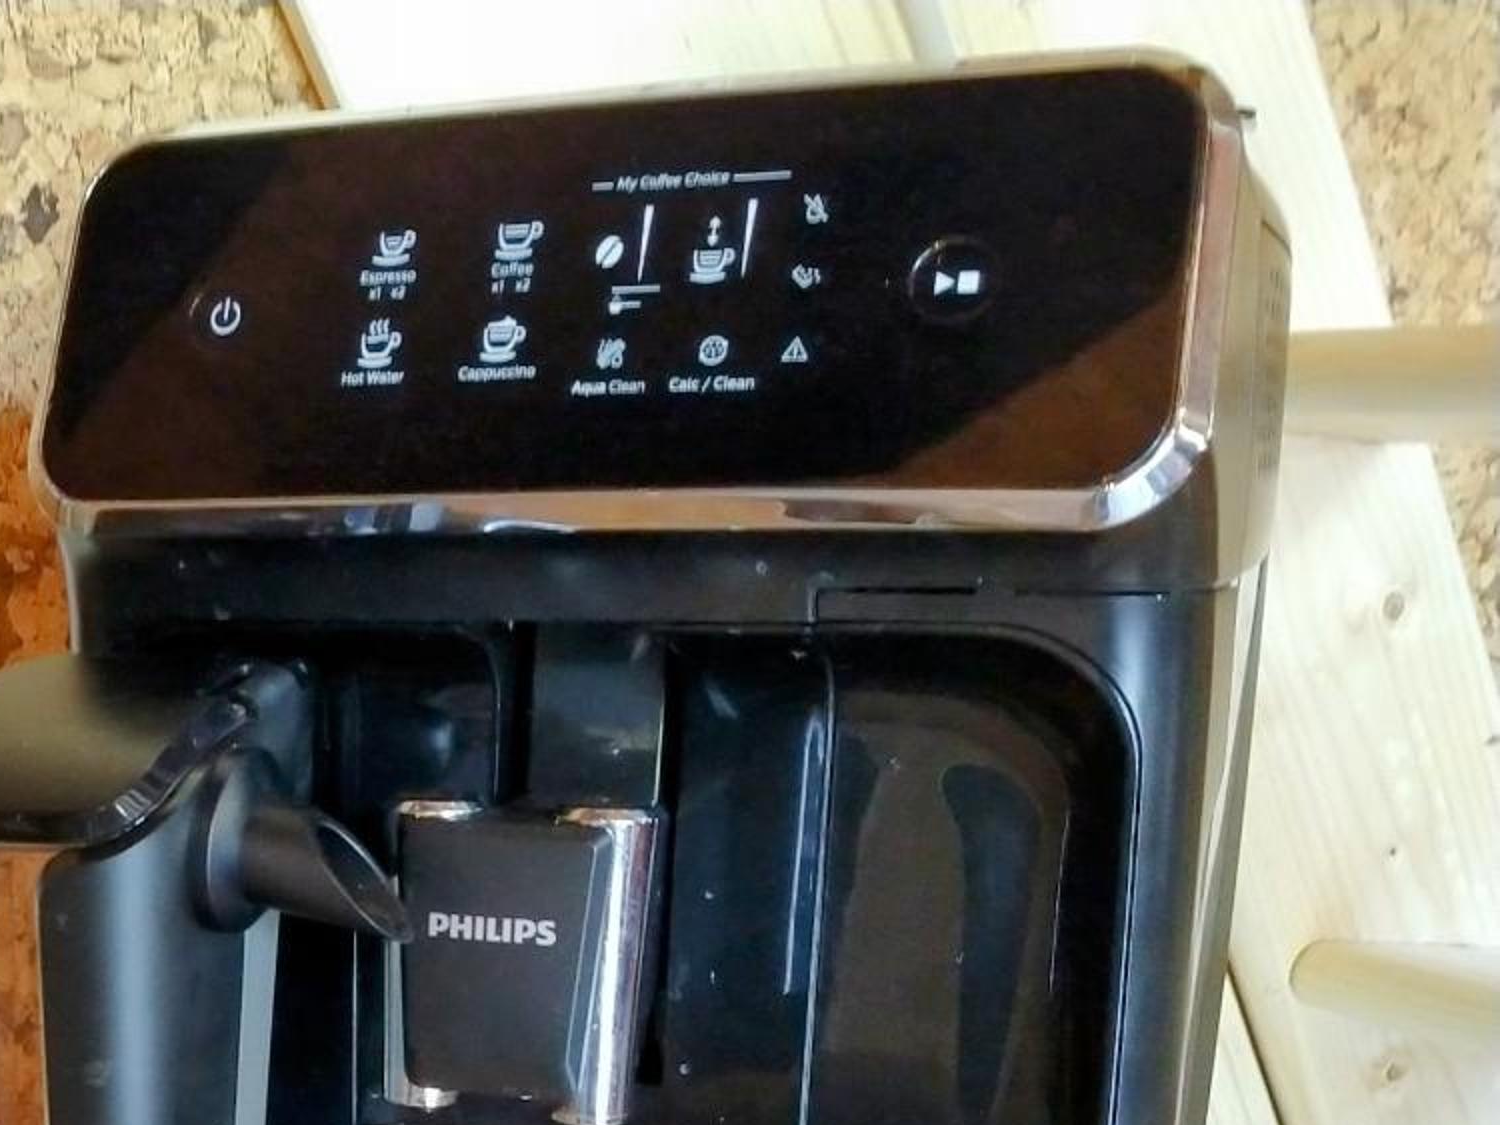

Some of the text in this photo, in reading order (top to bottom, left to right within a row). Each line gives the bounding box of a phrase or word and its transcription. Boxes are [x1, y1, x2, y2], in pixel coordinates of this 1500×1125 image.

[615, 170, 730, 193] My Coffee Choice
[360, 269, 417, 286] Espresso
[491, 261, 534, 278] Coffee
[341, 370, 404, 387] Hot Water
[458, 364, 537, 383] Cappuccino
[571, 379, 646, 397] Aqua Clean
[669, 375, 700, 393] Calc
[713, 374, 756, 392] Clean
[427, 911, 558, 947] PHILIPS
